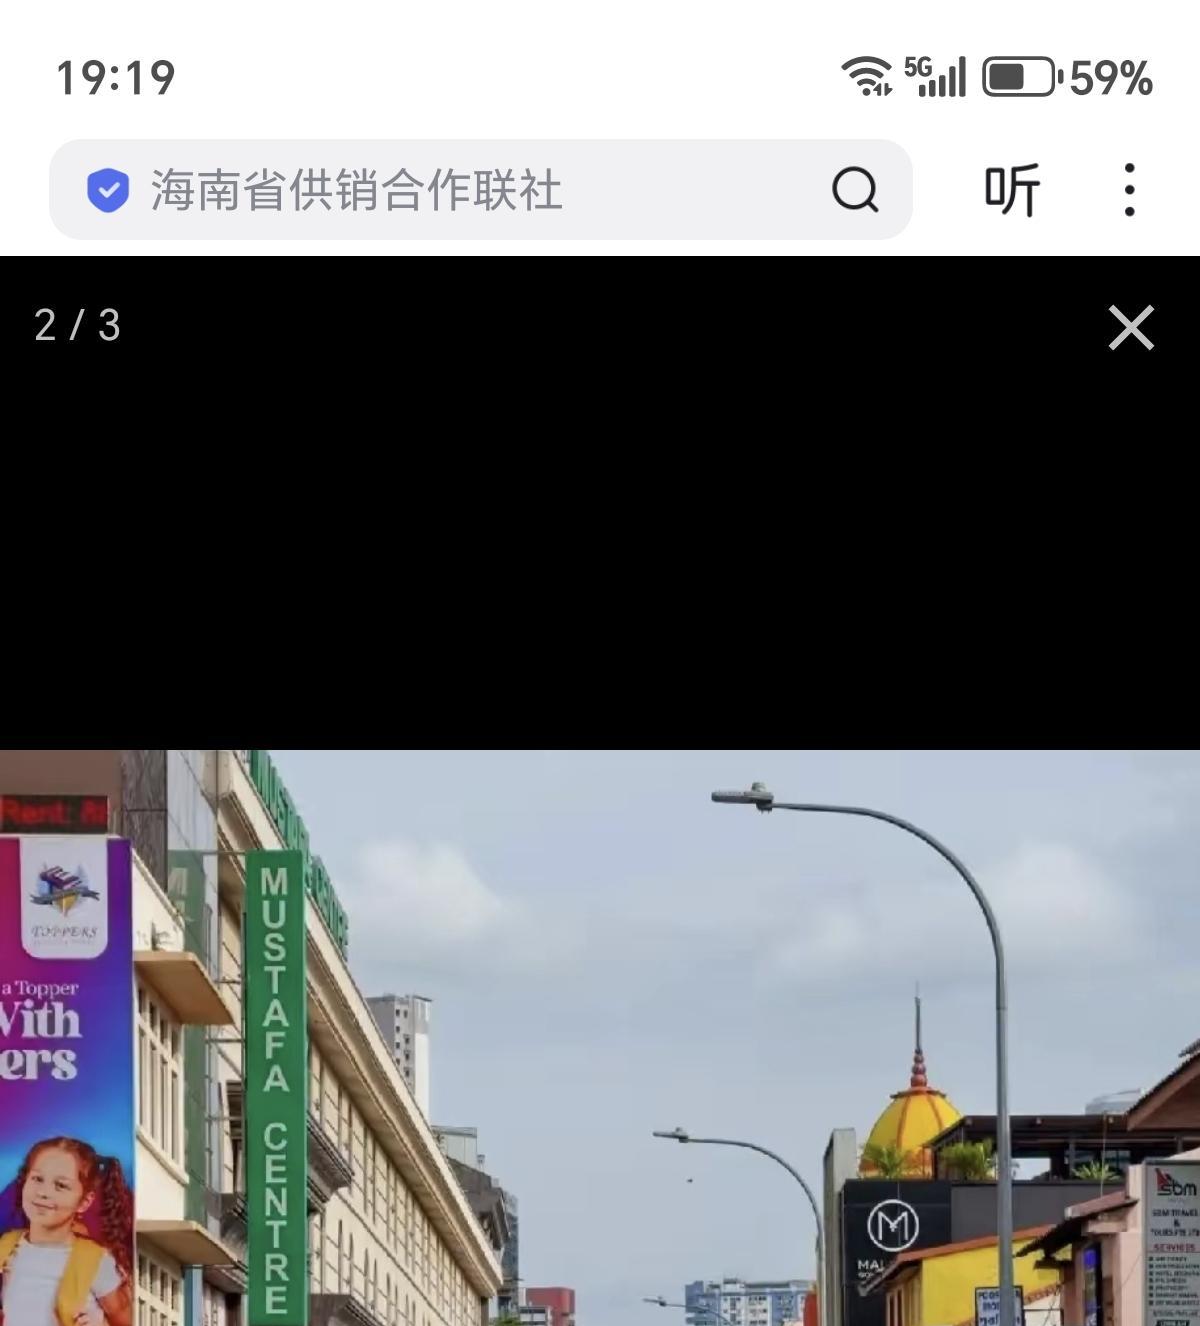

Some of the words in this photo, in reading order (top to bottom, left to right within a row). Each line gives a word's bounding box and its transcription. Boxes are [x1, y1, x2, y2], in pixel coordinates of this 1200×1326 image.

[32, 925, 98, 938] TOPPERS
[260, 867, 290, 1092] MUSTAFA
[2, 984, 10, 995] a
[15, 980, 80, 1001] Topper
[263, 1122, 290, 1315] CENTRE
